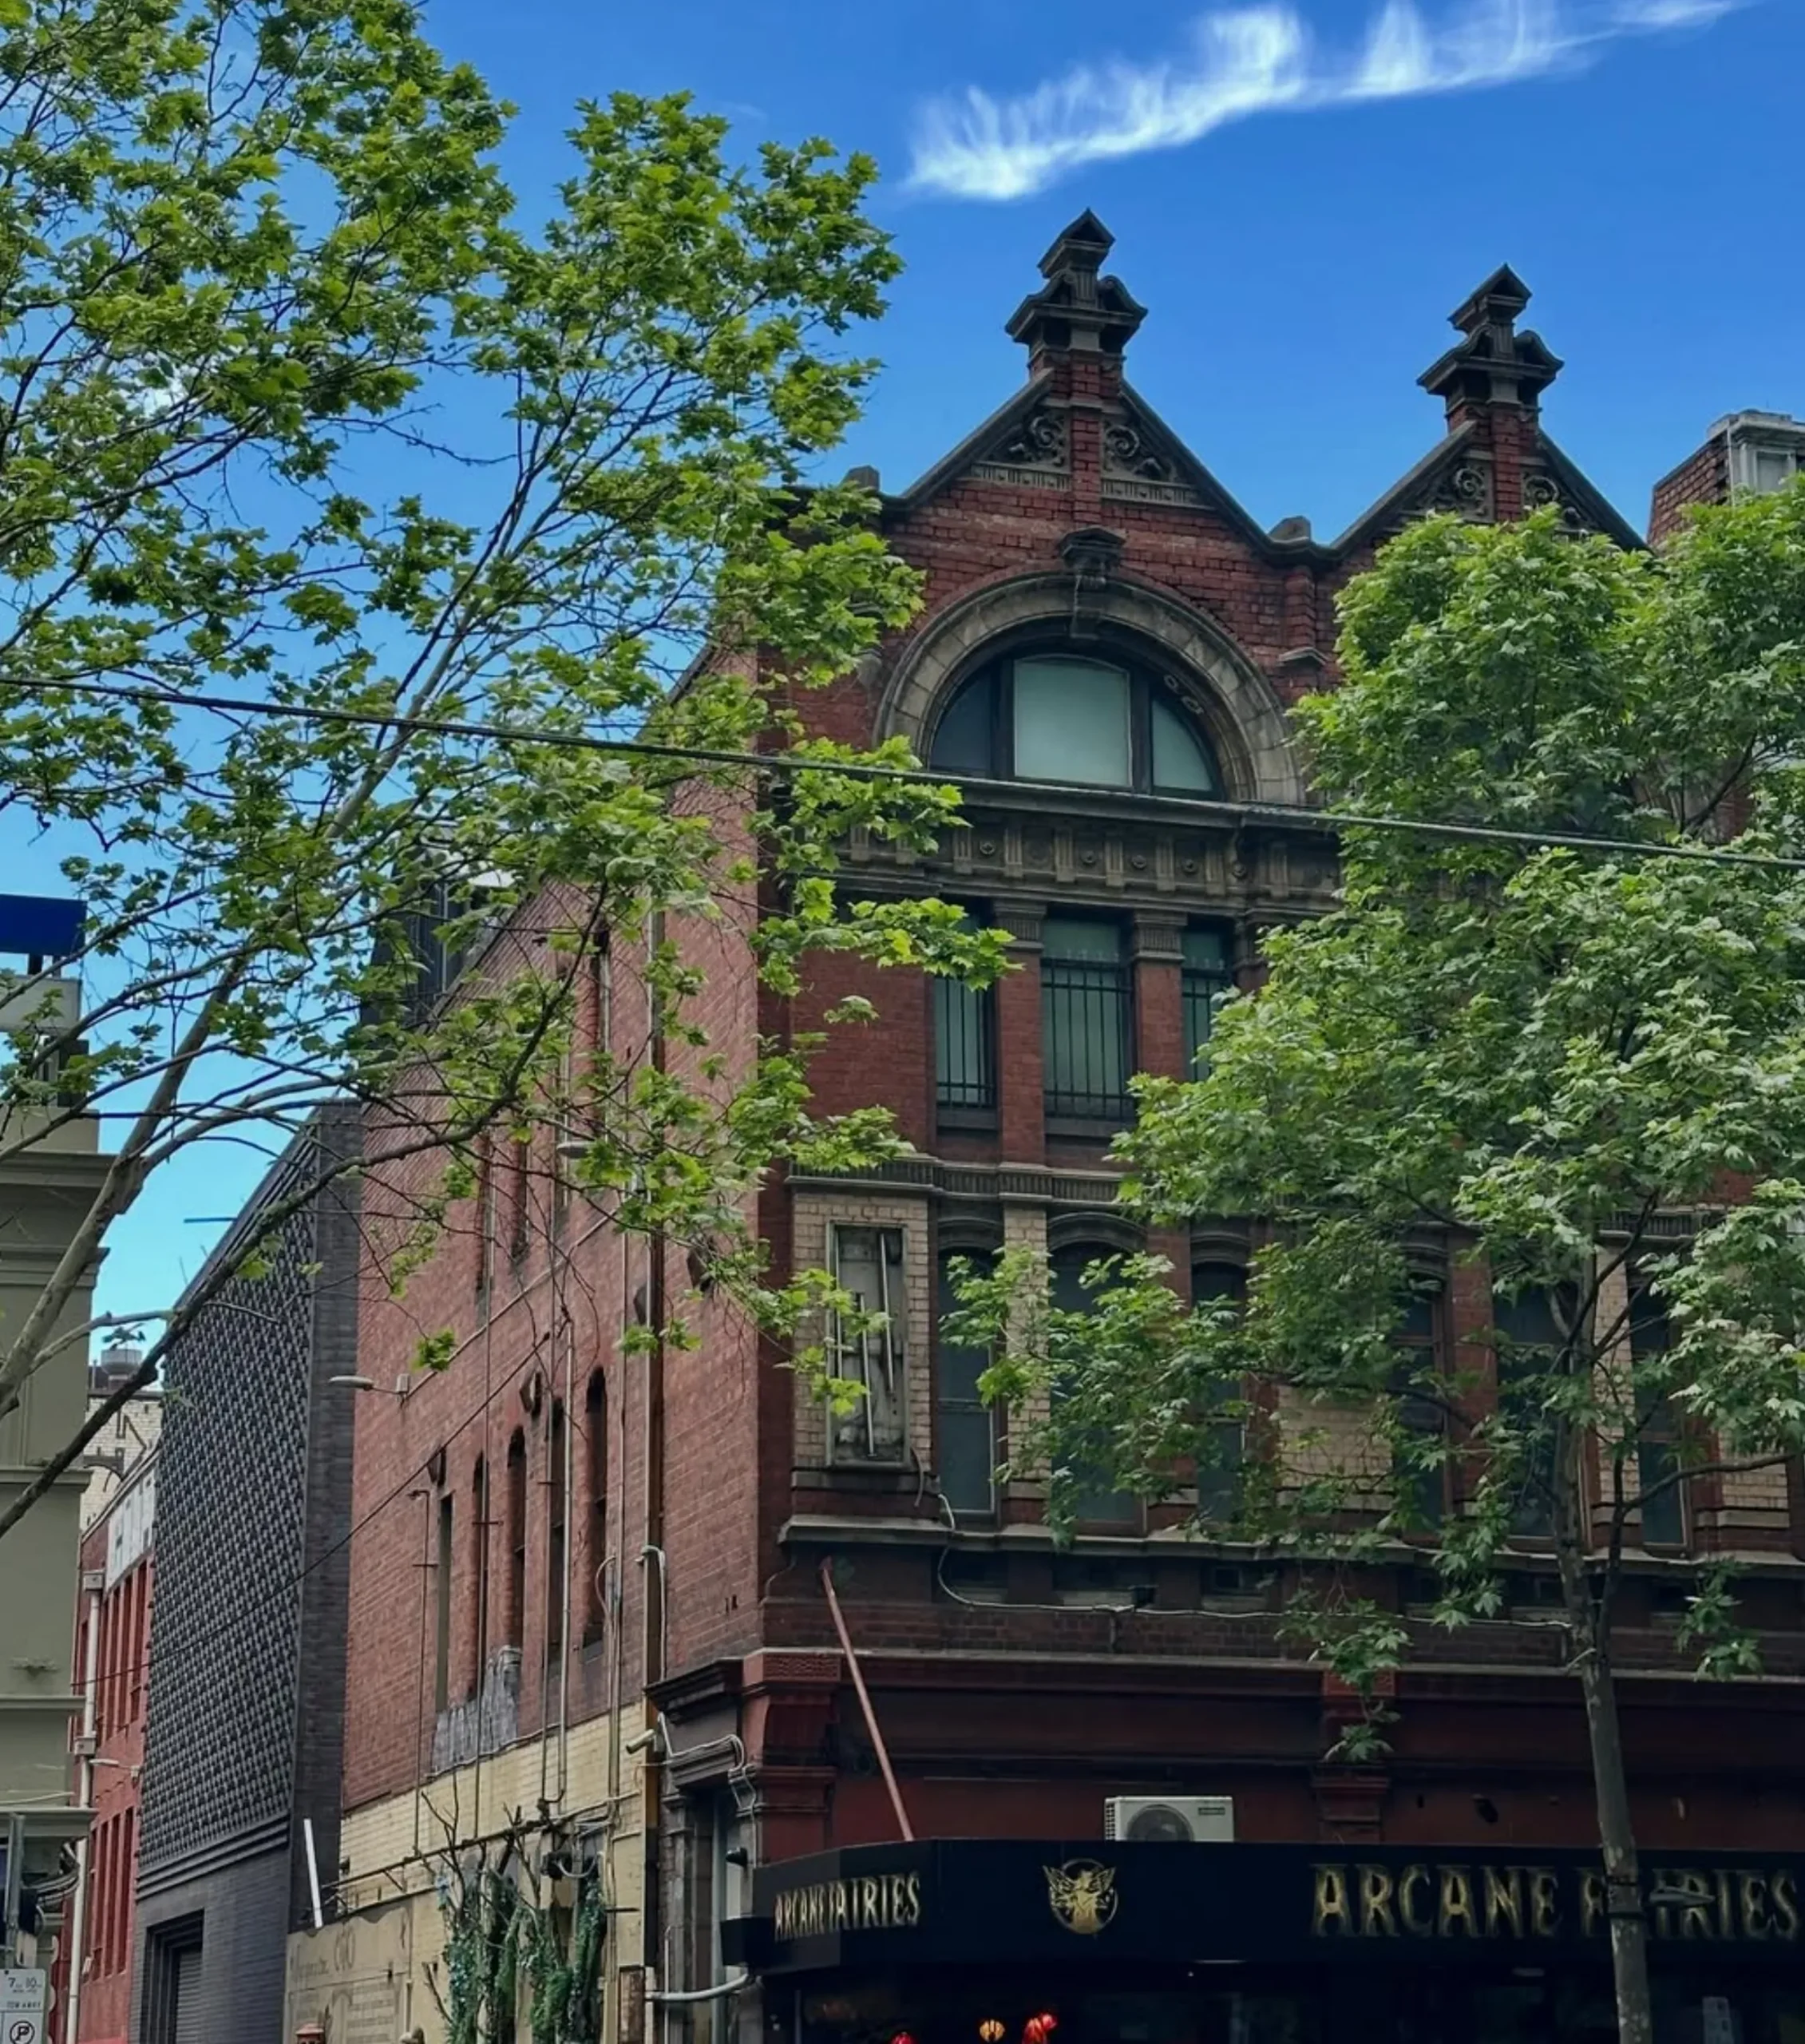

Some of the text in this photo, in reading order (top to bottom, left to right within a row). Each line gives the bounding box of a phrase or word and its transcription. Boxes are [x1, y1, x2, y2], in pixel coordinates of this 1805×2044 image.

[774, 1884, 825, 1943] ARCANE
[1311, 1864, 1800, 1942] ARCANE FIRIES
